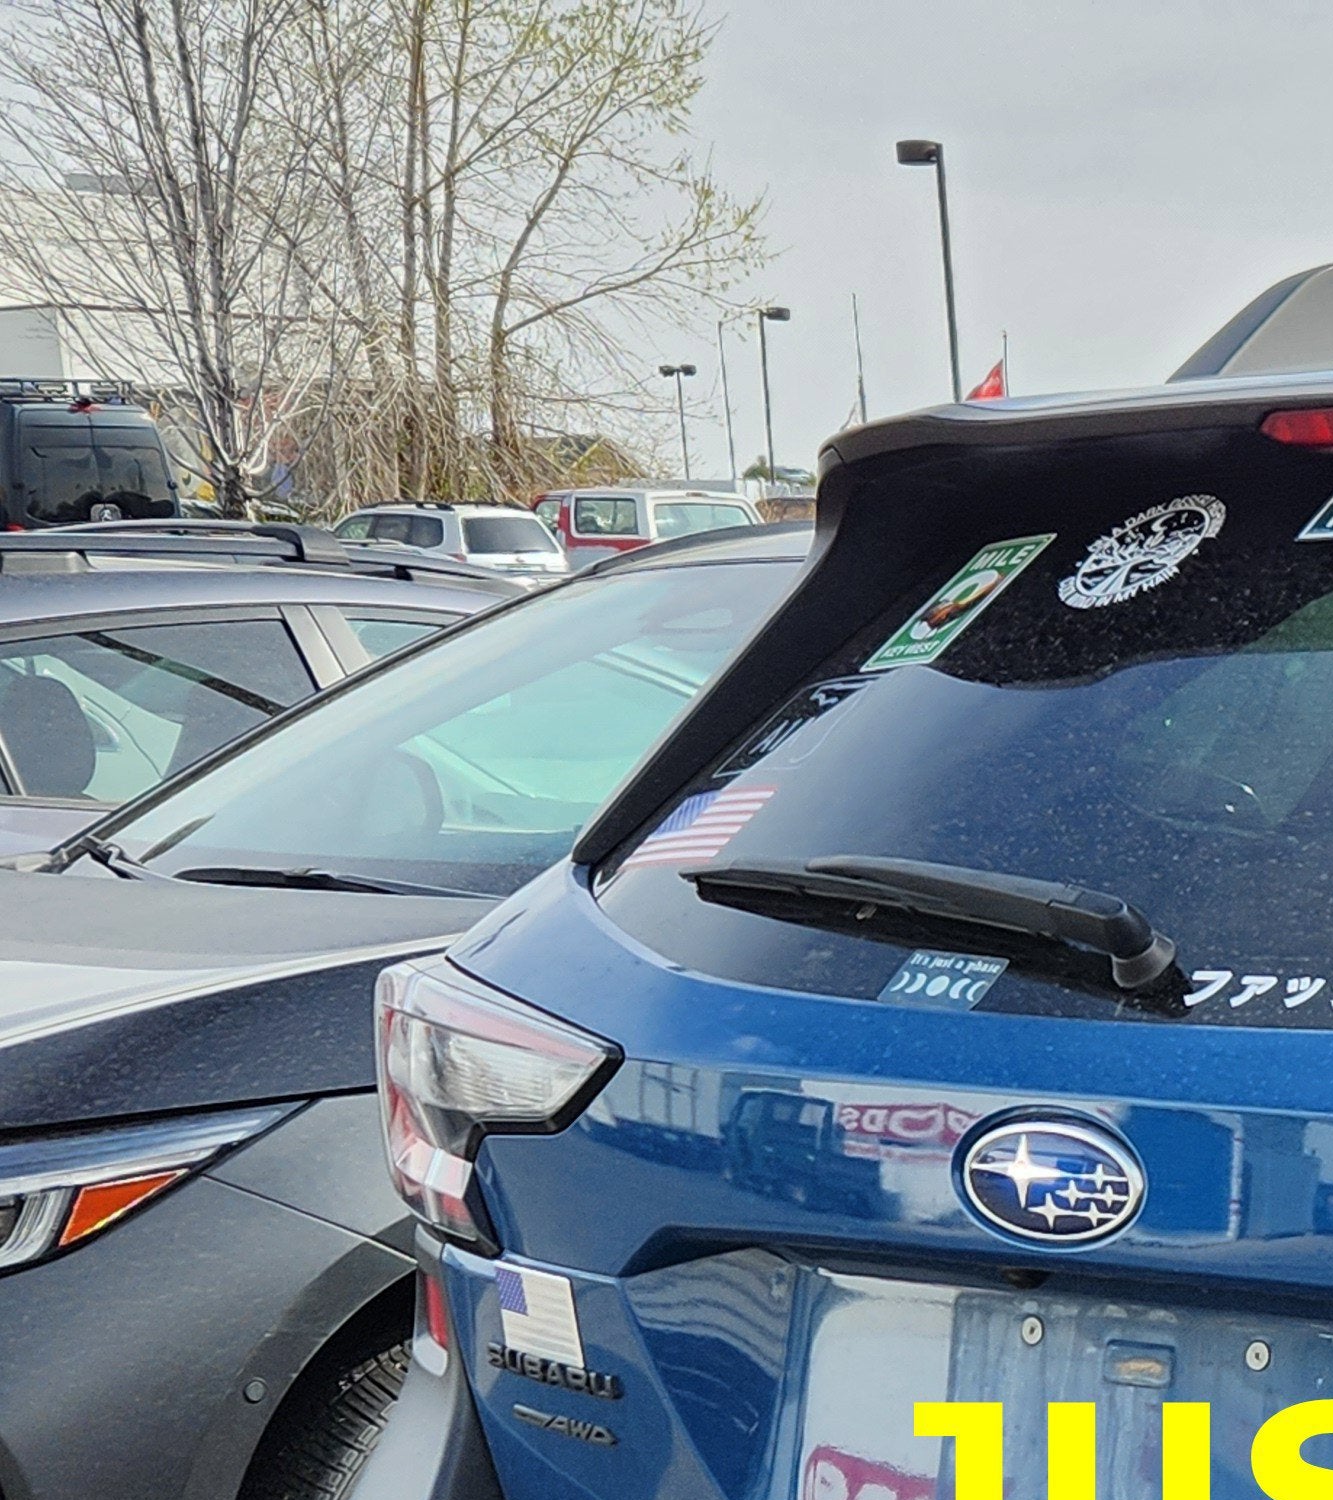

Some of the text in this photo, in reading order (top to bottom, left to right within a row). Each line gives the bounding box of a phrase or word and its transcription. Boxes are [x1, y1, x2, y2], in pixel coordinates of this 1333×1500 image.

[1124, 502, 1167, 527] DARK
[969, 544, 1037, 571] MILE
[487, 1341, 619, 1400] SUBARU
[552, 1415, 618, 1446] AWD
